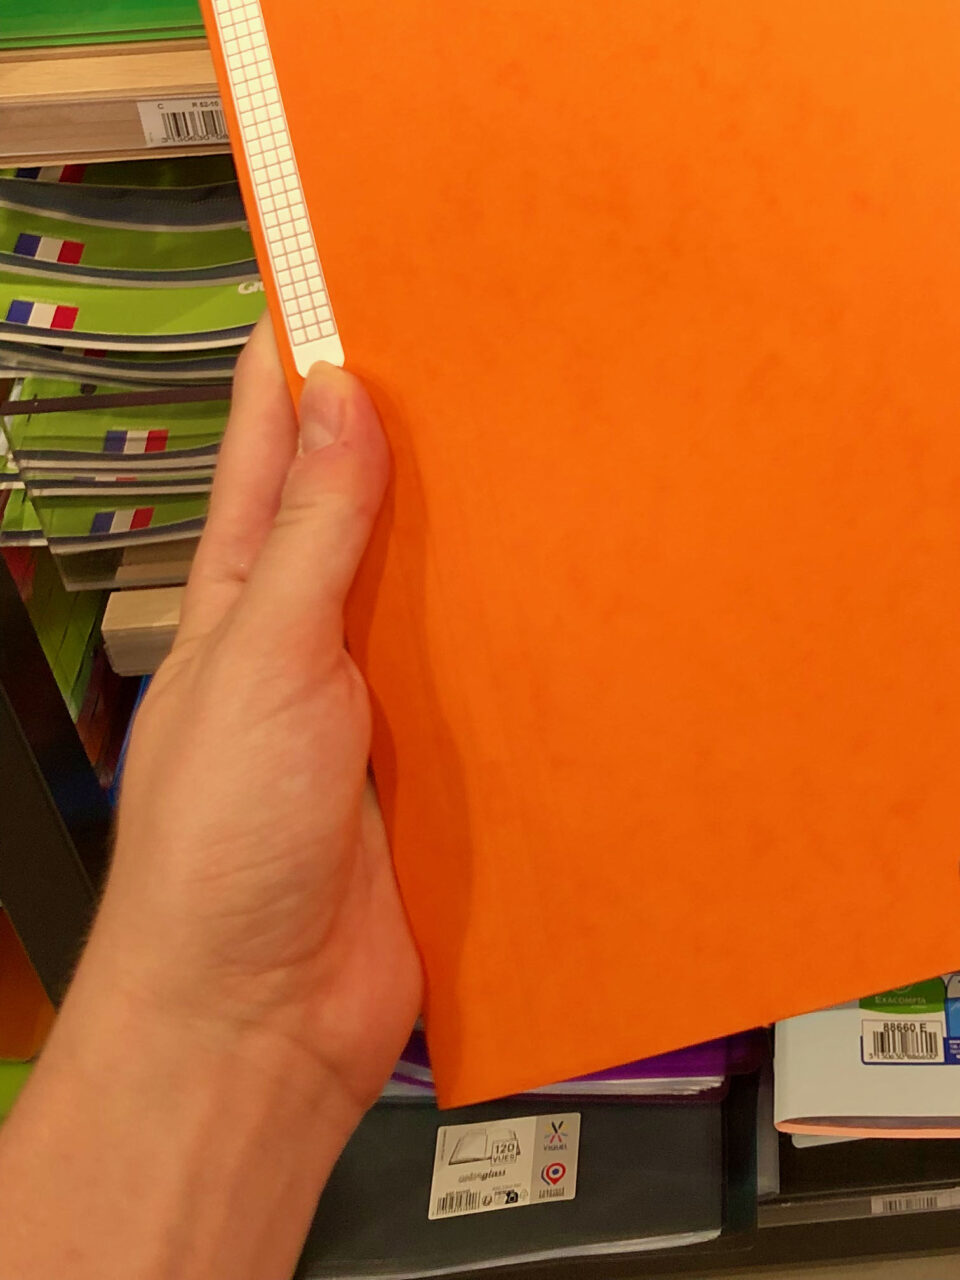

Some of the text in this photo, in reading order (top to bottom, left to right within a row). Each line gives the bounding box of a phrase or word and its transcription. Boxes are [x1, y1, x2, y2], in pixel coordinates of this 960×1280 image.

[883, 1023, 927, 1033] 88660 E
[495, 1143, 515, 1154] 120
